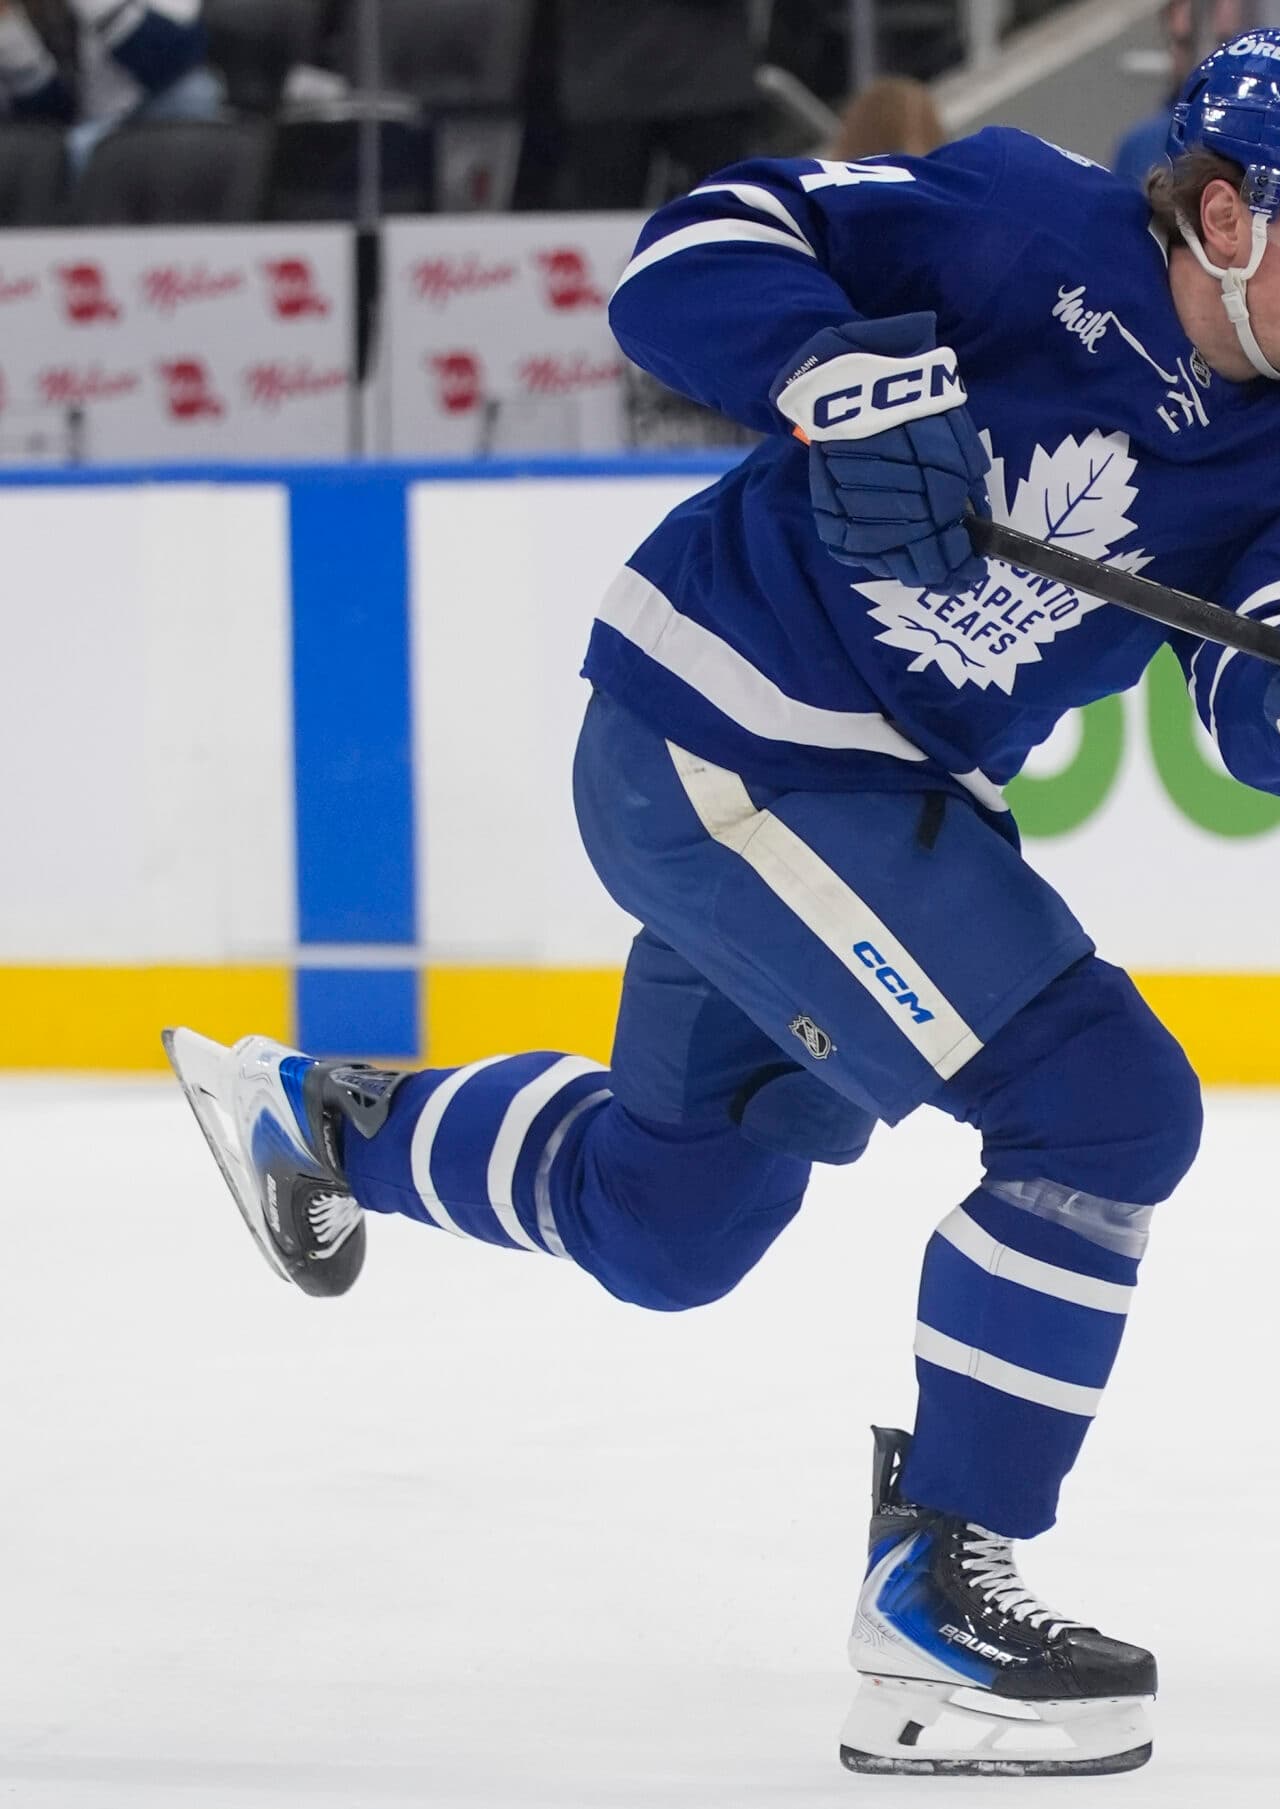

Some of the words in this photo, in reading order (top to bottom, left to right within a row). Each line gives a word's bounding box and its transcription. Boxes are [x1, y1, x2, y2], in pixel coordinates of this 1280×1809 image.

[799, 154, 916, 193] 4
[1052, 285, 1112, 354] Milk
[812, 363, 961, 430] CCM
[916, 588, 1018, 655] LEAFS
[966, 573, 1045, 634] APLE
[852, 940, 935, 1025] CCM
